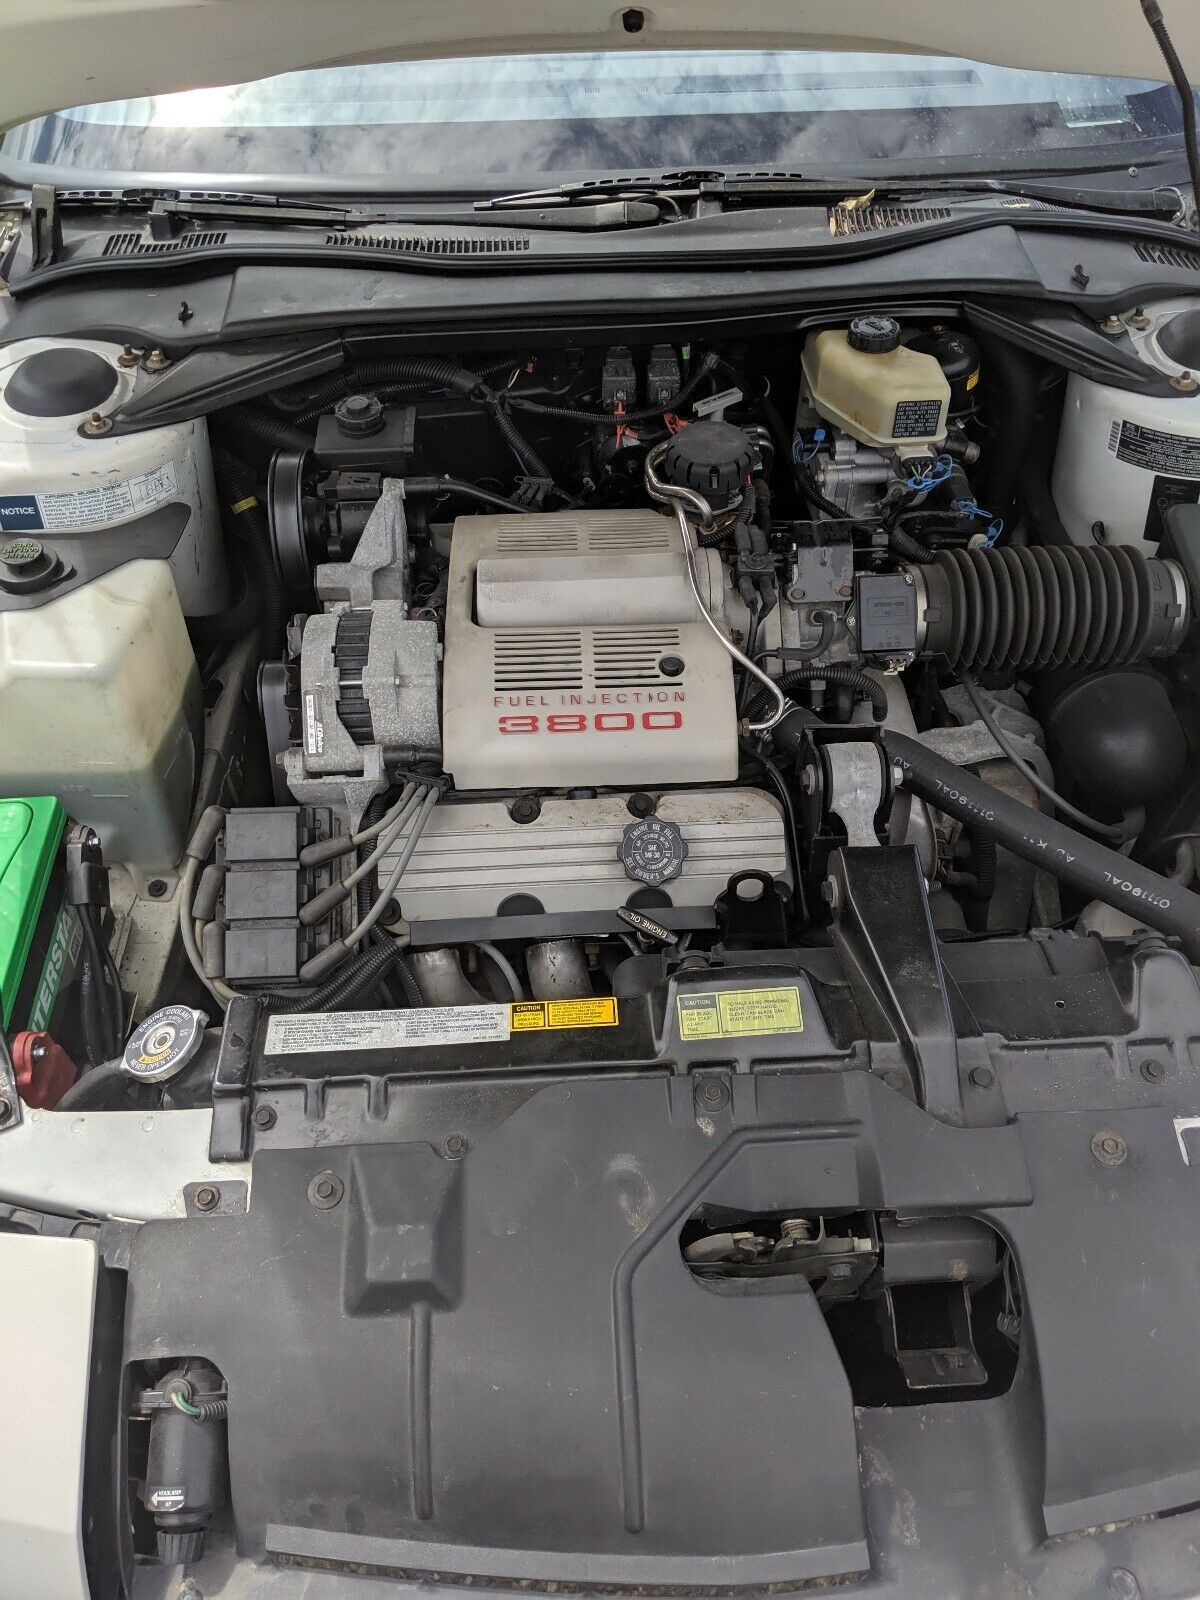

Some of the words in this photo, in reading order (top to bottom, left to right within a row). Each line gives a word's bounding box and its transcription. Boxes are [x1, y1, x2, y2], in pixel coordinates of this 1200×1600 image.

[1, 506, 36, 516] NOTICE
[494, 695, 549, 707] FUEL
[562, 692, 686, 704] INJECTION
[498, 711, 682, 734] 3800
[630, 824, 648, 839] ENGINE
[664, 828, 675, 840] FILL
[626, 857, 635, 868] SEE
[634, 868, 660, 880] OWNER'S
[662, 858, 679, 876] MANUAL
[630, 912, 640, 922] OIL
[642, 920, 668, 938] ENGINE
[138, 1012, 164, 1032] ENGINE
[166, 1008, 192, 1020] COOLANT
[130, 1058, 146, 1070] NEVER
[147, 1060, 166, 1070] OPEN
[166, 1048, 180, 1061] HOT
